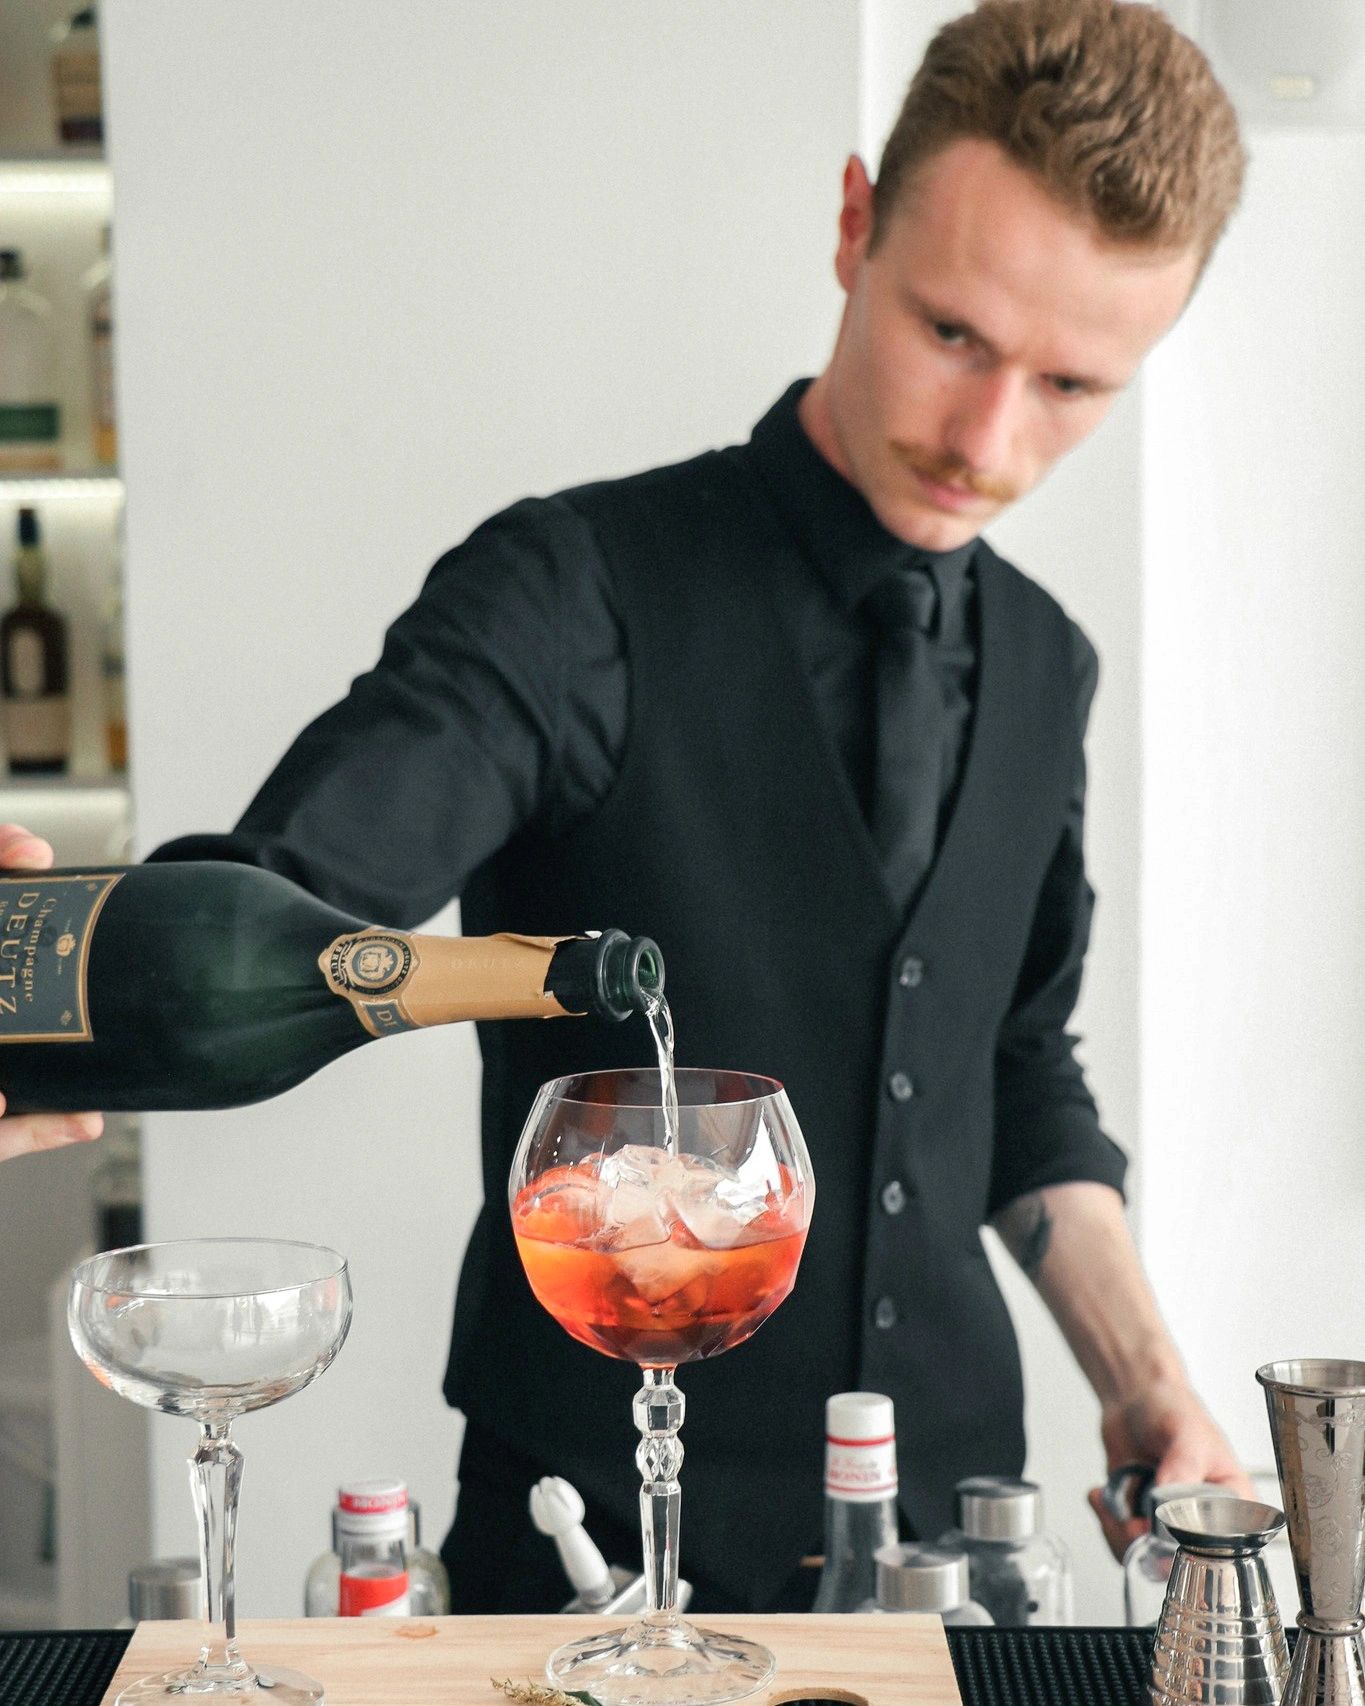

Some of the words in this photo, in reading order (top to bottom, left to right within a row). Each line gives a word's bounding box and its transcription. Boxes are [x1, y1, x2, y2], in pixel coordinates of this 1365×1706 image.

[0, 891, 40, 1014] DEUTZ
[21, 898, 57, 1002] Champagne
[331, 946, 343, 978] BRUT
